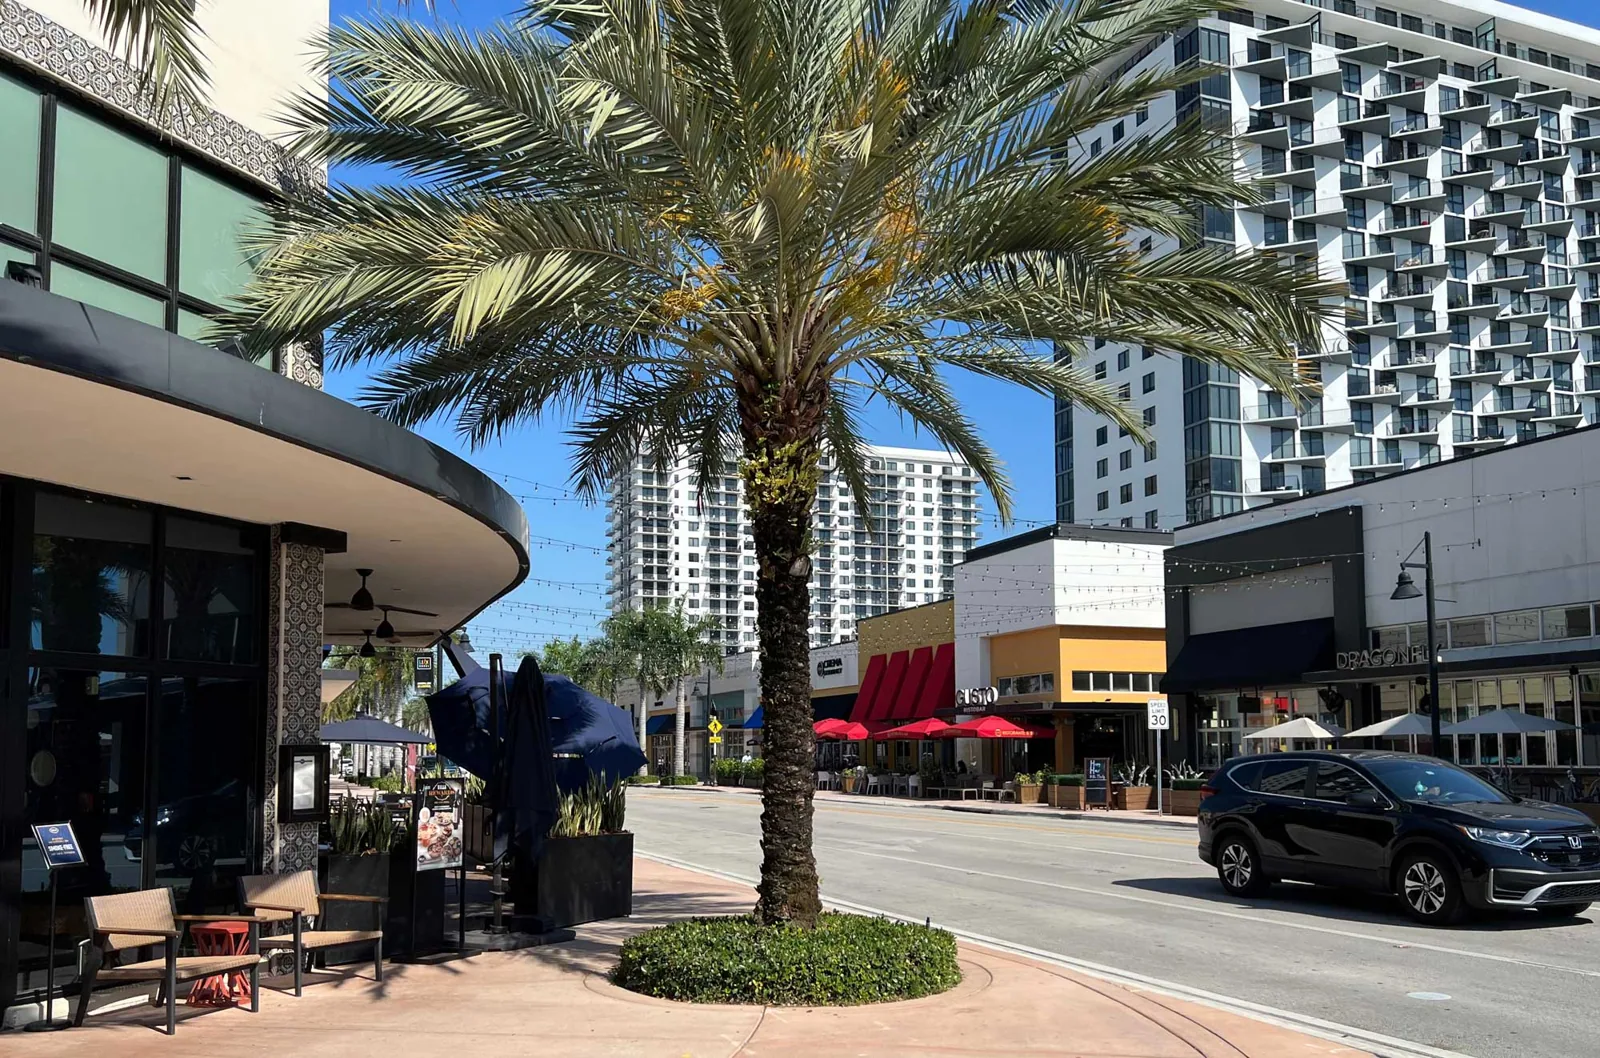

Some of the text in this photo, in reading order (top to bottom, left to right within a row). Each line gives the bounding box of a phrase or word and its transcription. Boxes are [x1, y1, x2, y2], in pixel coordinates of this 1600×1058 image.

[1336, 643, 1441, 669] DRAGONFL
[956, 686, 999, 706] GUSTO
[1151, 714, 1166, 726] 30
